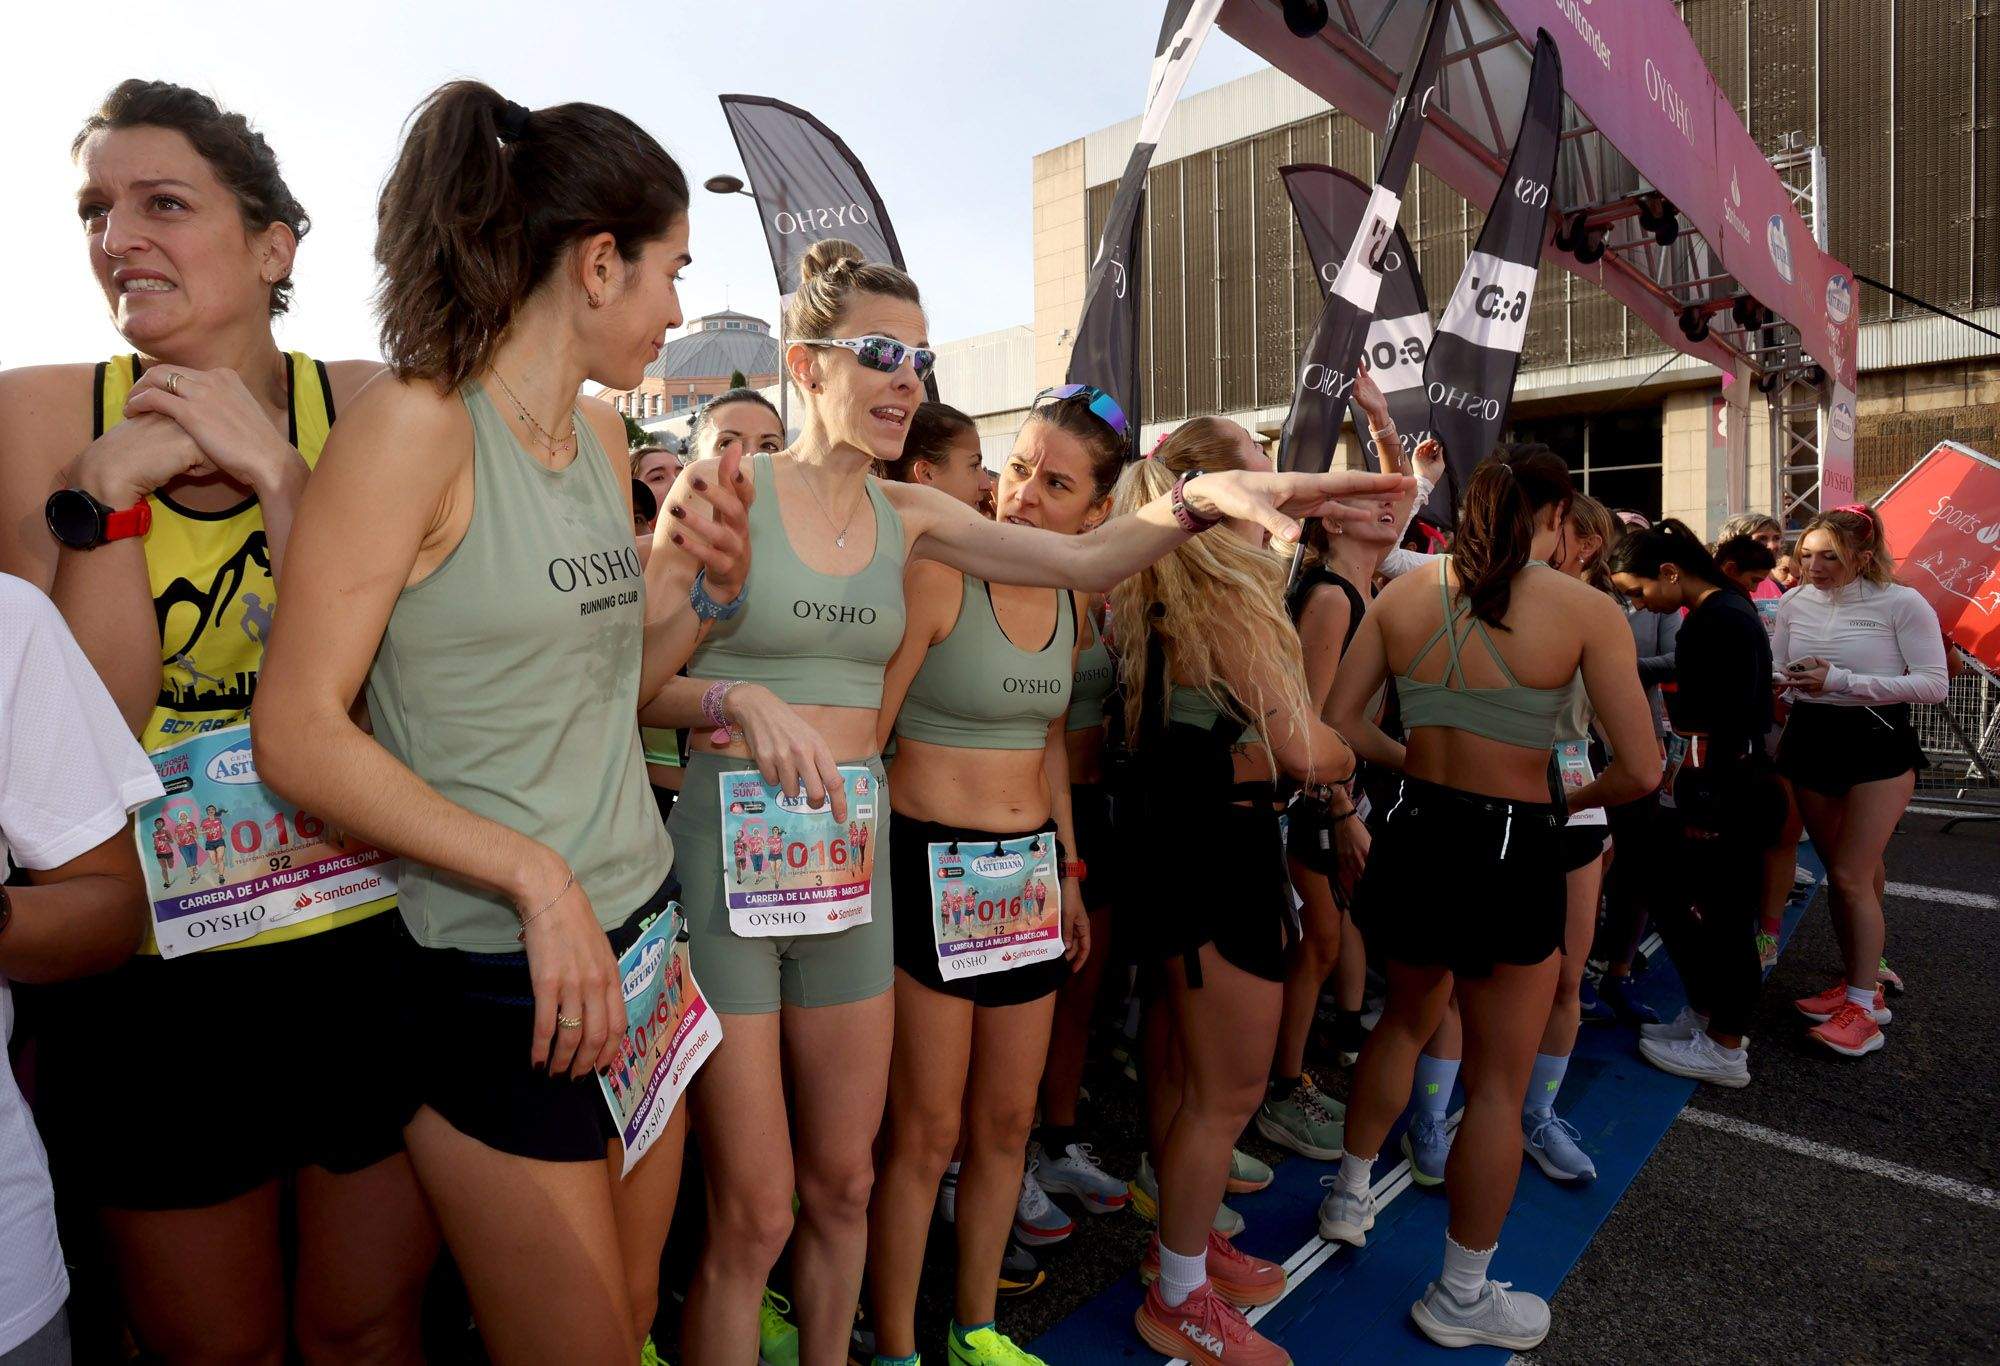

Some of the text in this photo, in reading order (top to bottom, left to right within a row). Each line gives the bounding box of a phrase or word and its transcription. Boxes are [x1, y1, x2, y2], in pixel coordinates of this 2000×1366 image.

[1556, 0, 1611, 71] antander
[1645, 58, 1695, 147] OYSHO
[1823, 469, 1853, 494] OYSHO
[1928, 495, 1981, 534] Sports
[548, 546, 641, 593] OYSHO
[580, 590, 639, 616] RUNNING CLUB
[793, 600, 877, 625] OYSHO
[1003, 677, 1062, 694] OYSHO
[1073, 666, 1109, 683] OYSHO
[230, 810, 325, 854] 016
[269, 855, 292, 871] 92
[786, 838, 848, 869] 016
[976, 858, 1023, 873] ASTURIANA
[179, 850, 380, 911] CARRERA DE LA MUJER BARCELONA
[314, 876, 382, 904] Santander
[815, 874, 823, 887] 3
[745, 893, 784, 904] CARRERA
[786, 892, 798, 901] DE
[800, 892, 811, 900] LA
[812, 889, 838, 899] MUJER
[978, 896, 1022, 922] 016
[187, 905, 266, 938] OYSHO
[749, 911, 806, 926] OYSHO
[993, 925, 1005, 935] 12
[949, 941, 975, 952] CARRERA
[1015, 930, 1049, 942] BARCELONA
[951, 955, 987, 971] OYSHO
[635, 992, 668, 1058] 016
[655, 1046, 661, 1059] 4
[677, 1029, 710, 1076] Santander
[632, 1093, 651, 1131] CARRERA
[638, 1097, 665, 1151] OYSHO
[1179, 1319, 1224, 1359] HOKA
